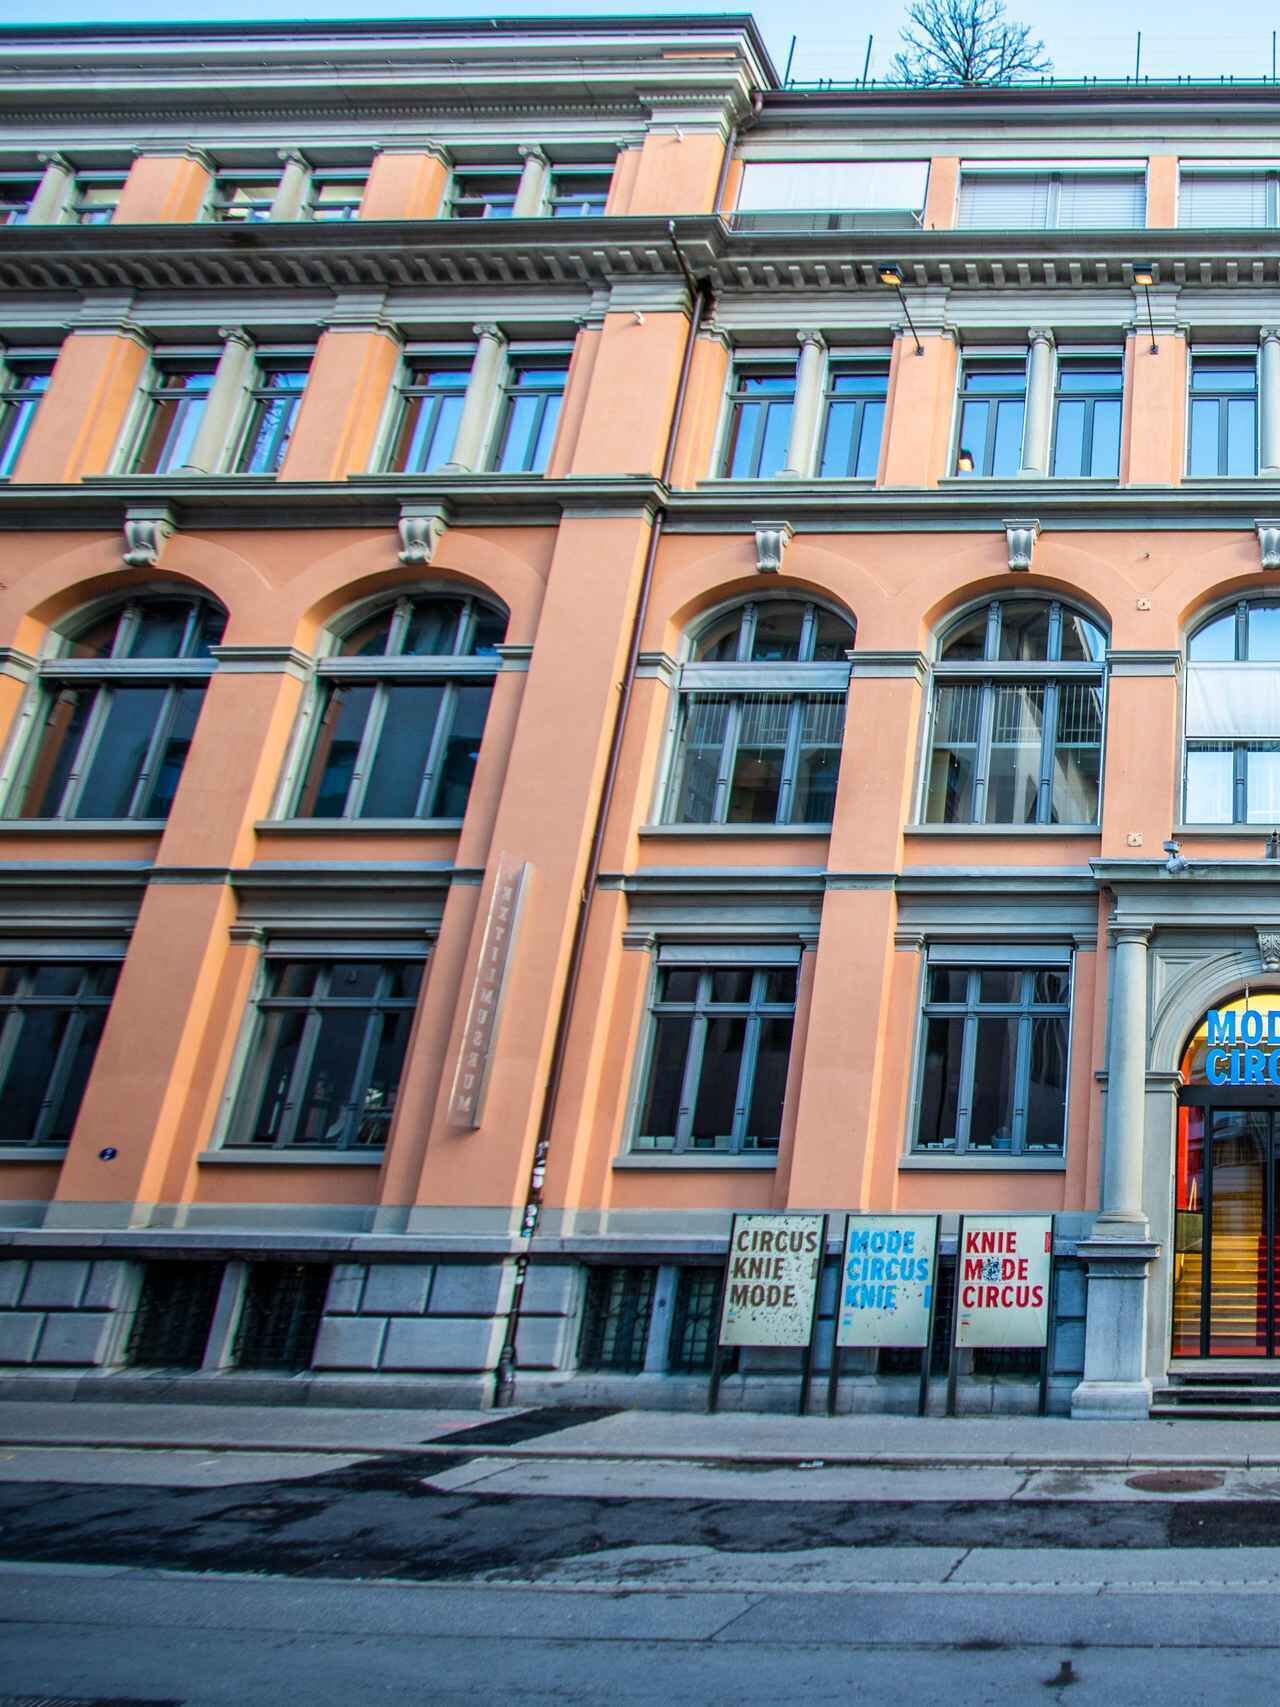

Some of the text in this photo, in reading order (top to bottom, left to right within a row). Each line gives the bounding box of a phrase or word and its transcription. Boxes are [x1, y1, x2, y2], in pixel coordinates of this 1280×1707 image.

[737, 1230, 817, 1252] CIRCUS
[848, 1231, 916, 1253] MODE
[965, 1232, 1017, 1253] KNIE
[732, 1257, 785, 1280] KNIE
[846, 1257, 929, 1281] CIRCUS
[729, 1284, 796, 1308] MODE
[844, 1285, 897, 1308] KNIE
[962, 1285, 1044, 1308] CIRCUS
